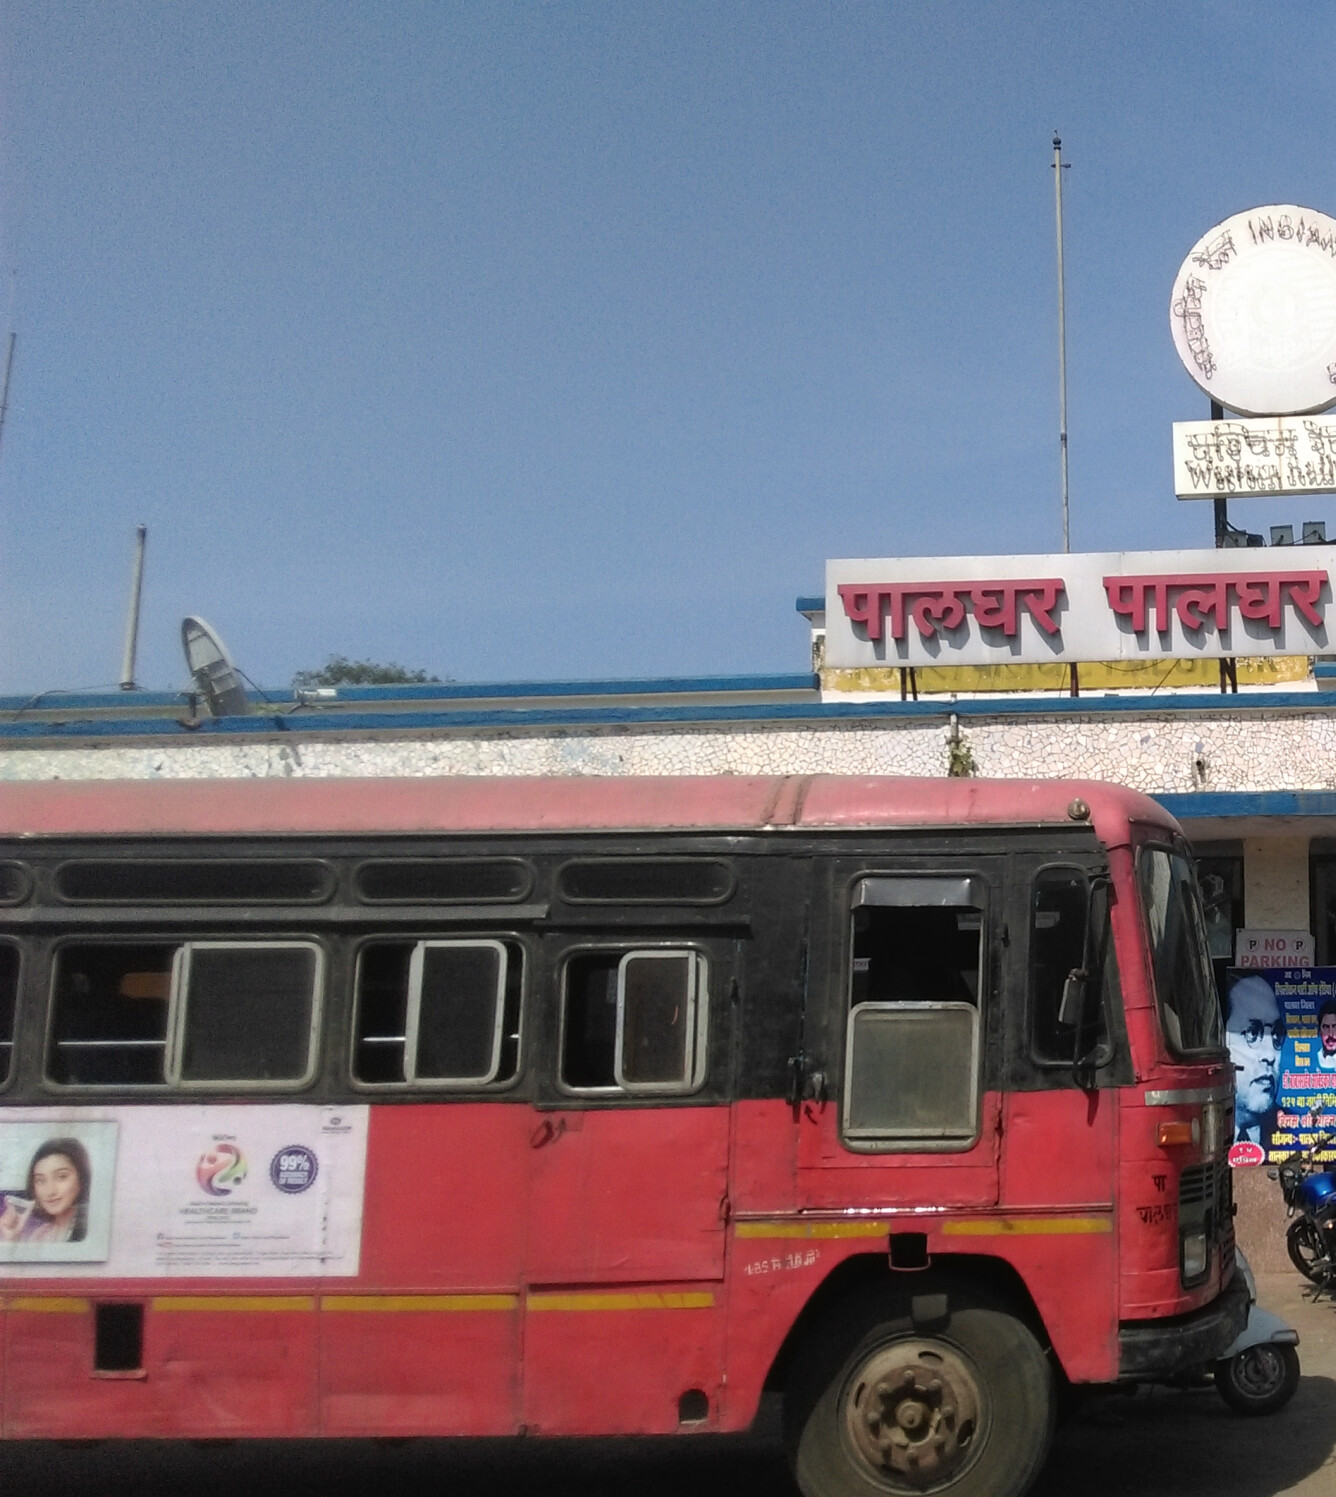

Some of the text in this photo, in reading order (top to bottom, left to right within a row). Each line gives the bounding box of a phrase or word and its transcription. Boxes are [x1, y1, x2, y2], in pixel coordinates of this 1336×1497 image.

[1185, 459, 1283, 492] Western
[838, 569, 1331, 641] पालघर पालघर
[1264, 939, 1286, 950] NO
[1241, 955, 1310, 967] PARKING
[279, 1154, 310, 1171] 99%
[1151, 1175, 1167, 1192] पा
